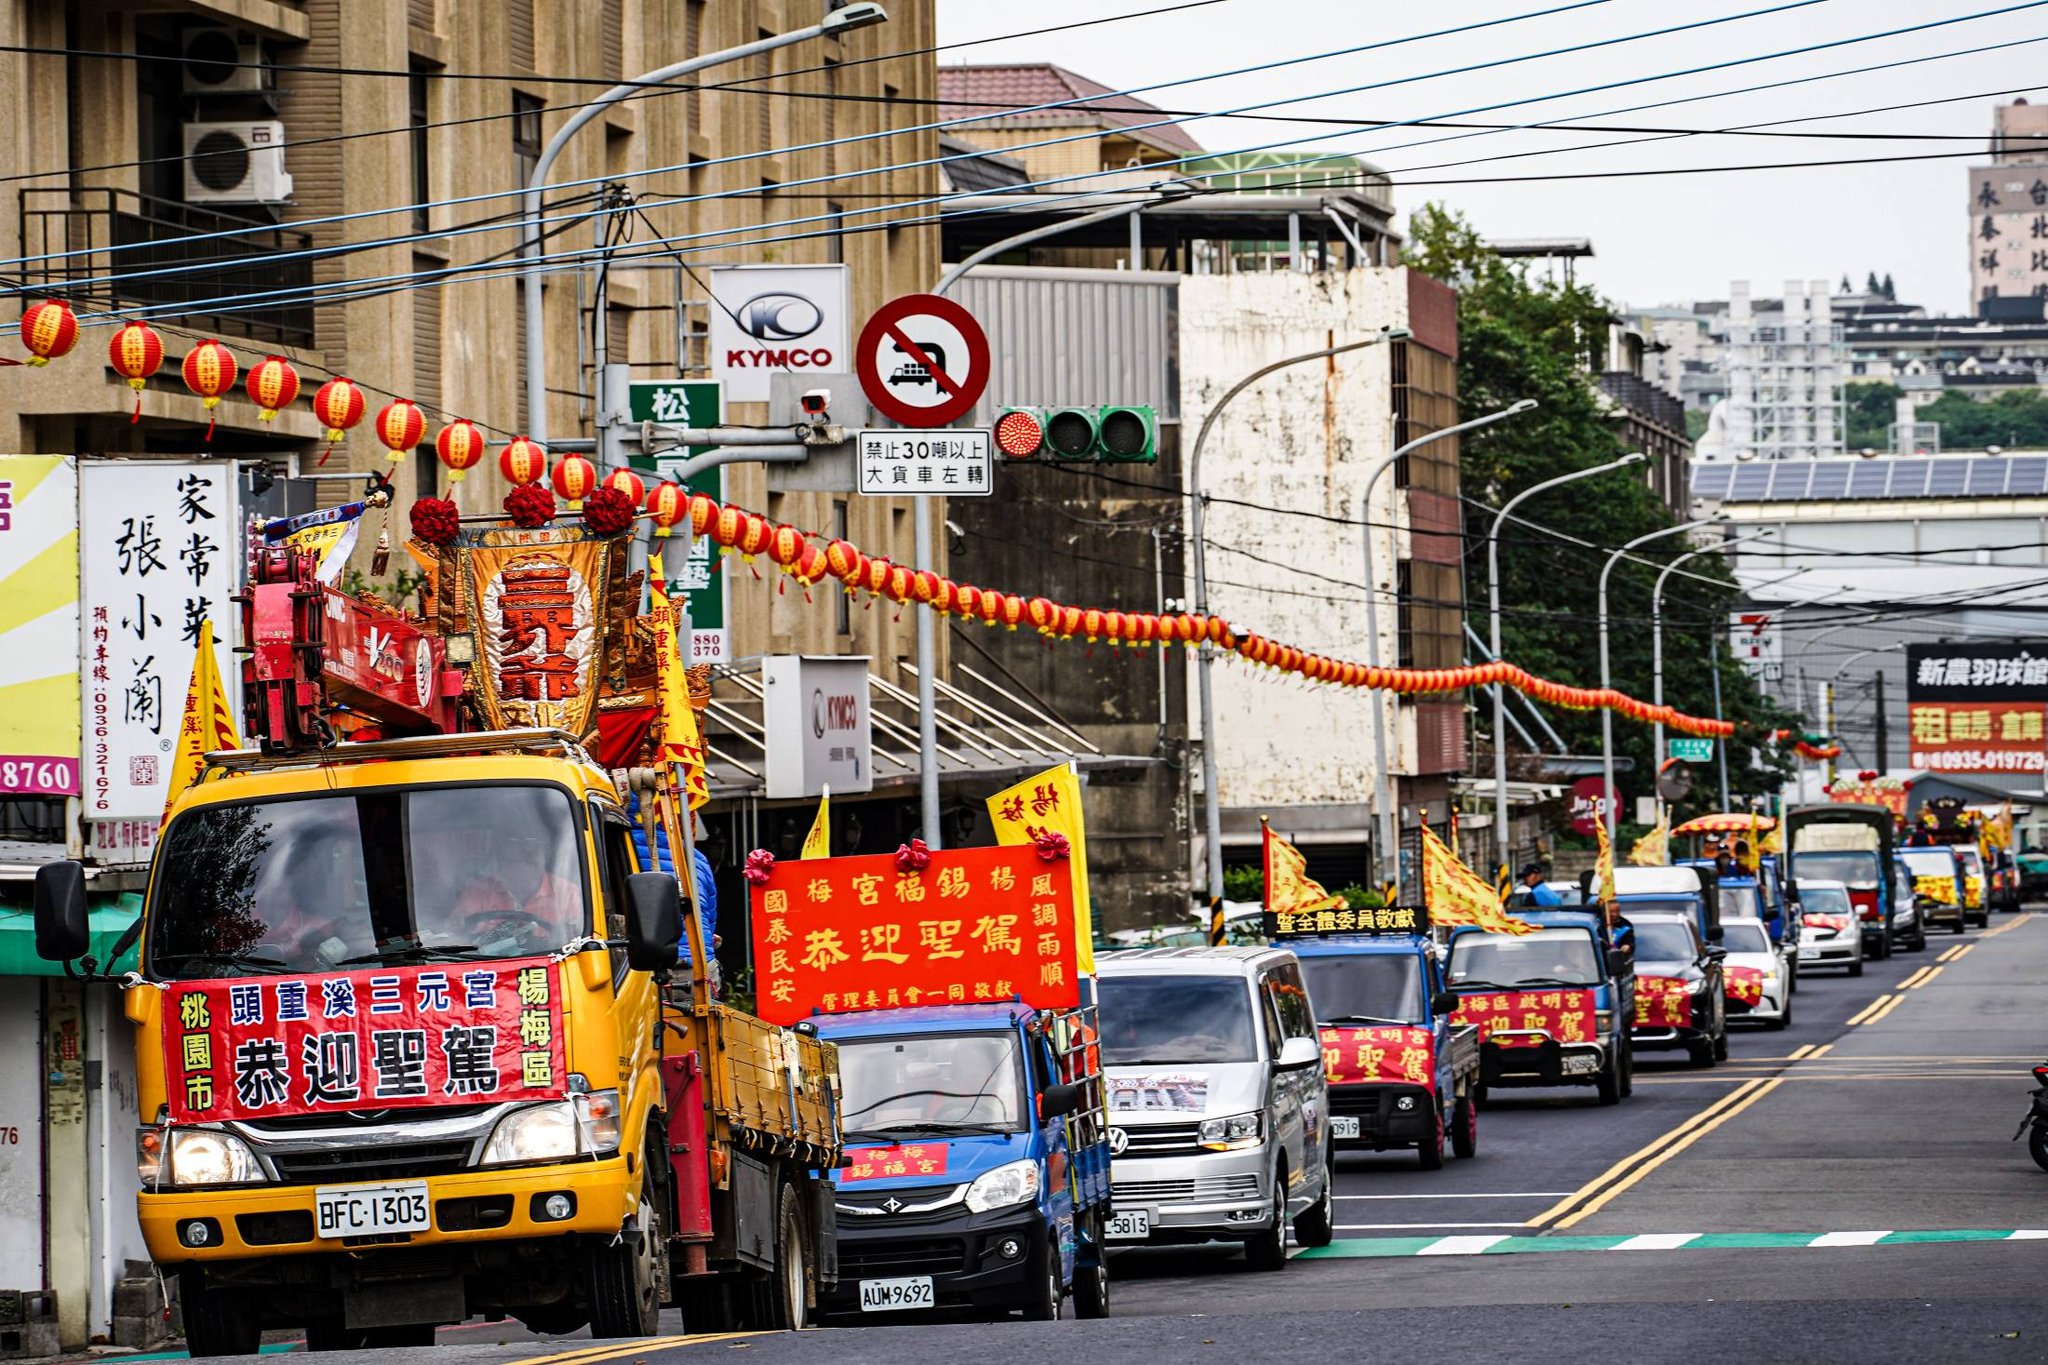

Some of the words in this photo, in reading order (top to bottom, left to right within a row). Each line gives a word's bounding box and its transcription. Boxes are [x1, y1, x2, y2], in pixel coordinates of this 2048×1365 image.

[727, 348, 832, 368] KYMCO
[866, 441, 983, 459] 禁止30噸以上
[866, 466, 983, 484] 大貨車左轉
[176, 473, 222, 650] 家常菜
[114, 515, 167, 735] 張小蘭
[693, 634, 720, 645] 880
[693, 646, 720, 657] 370
[827, 695, 857, 730] KYMCO
[0, 761, 70, 790] 8760
[1030, 874, 1064, 987] 風調雨順
[1276, 908, 1416, 933] 暨全體委員敬獻
[764, 889, 796, 1003] 國泰民安
[801, 915, 1022, 972] 恭迎聖駕
[230, 969, 497, 1027] 頭重溪三元宮
[518, 967, 554, 1089] 楊梅區
[180, 992, 213, 1111] 桃園市
[235, 1026, 500, 1110] 恭迎聖駕
[1104, 1217, 1147, 1233] -5813
[863, 1284, 932, 1307] AUM-9692
